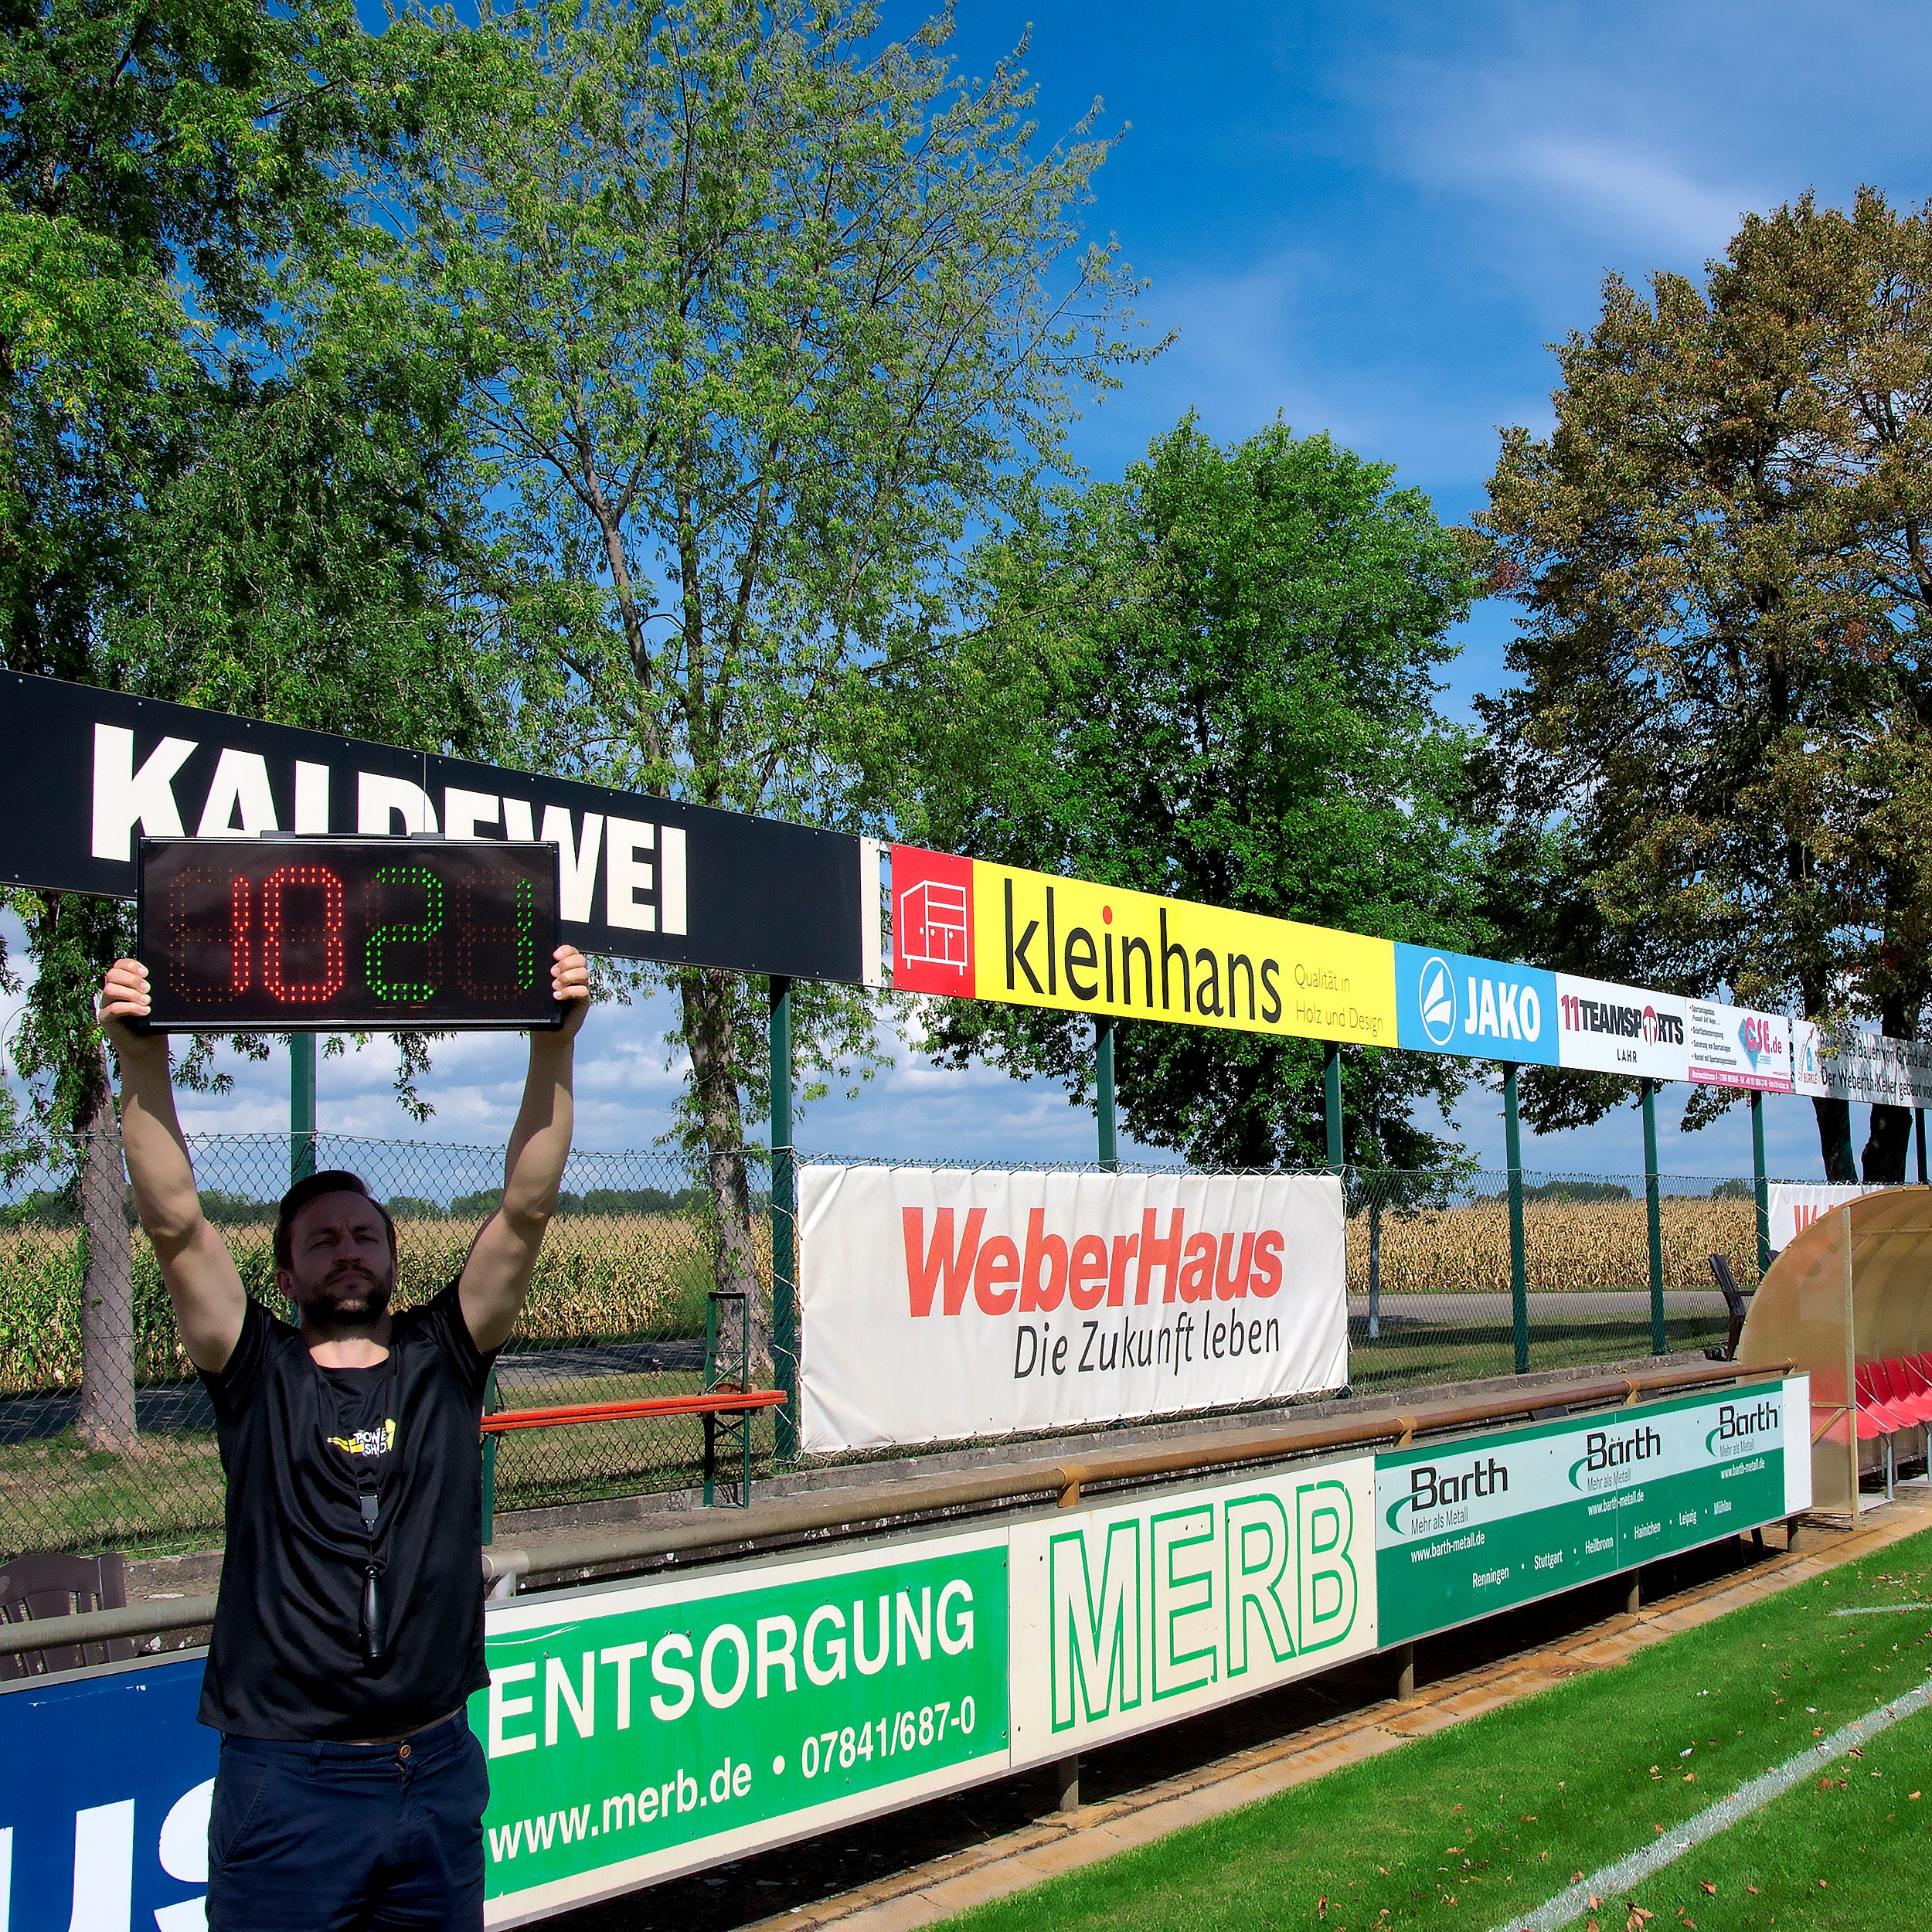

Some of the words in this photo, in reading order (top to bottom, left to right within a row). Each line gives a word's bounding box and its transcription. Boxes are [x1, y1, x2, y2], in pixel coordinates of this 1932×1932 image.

[233, 866, 344, 1002] 10
[1005, 878, 1281, 1023] kleinhans
[1294, 964, 1338, 991] Qualität
[1341, 971, 1350, 992] in
[1296, 1000, 1322, 1024] Holz
[1325, 1006, 1345, 1027] und
[1349, 1007, 1383, 1037] Design
[1464, 976, 1540, 1043] JAKO
[1617, 1049, 1638, 1063] LAHR
[1821, 1066, 1835, 1087] Der
[902, 1206, 1285, 1318] WeberHaus
[1014, 1324, 1066, 1379] Die
[1079, 1311, 1195, 1376] Zukunft
[1202, 1307, 1280, 1360] leben
[1719, 1401, 1778, 1440] Barth
[1587, 1426, 1661, 1471] Barth
[1719, 1444, 1732, 1458] Mehr
[1740, 1438, 1754, 1453] Metall
[1720, 1458, 1766, 1480] www.barth-metall.de
[1411, 1458, 1508, 1512] Barth
[1587, 1477, 1603, 1492] Mehr
[1604, 1473, 1613, 1488] als
[1614, 1468, 1631, 1485] Metall
[1411, 1518, 1431, 1536] Mehr
[1433, 1515, 1445, 1529] als
[1446, 1507, 1468, 1526] Metall
[1587, 1488, 1645, 1516] www.barth-metall.de
[1411, 1530, 1485, 1563] www.barth-metall.de
[1472, 1566, 1509, 1588] Renningen
[1534, 1549, 1563, 1570] Stuttgart
[1585, 1536, 1614, 1555] Heilbronn
[1634, 1522, 1661, 1540] Hainichen
[1679, 1509, 1697, 1526] Leipzig
[1049, 1479, 1357, 1734] MERB
[488, 1579, 975, 1760] ENTSORGUNG
[488, 1757, 753, 1863] www.merb.de
[801, 1696, 976, 1779] 07841/687-0
